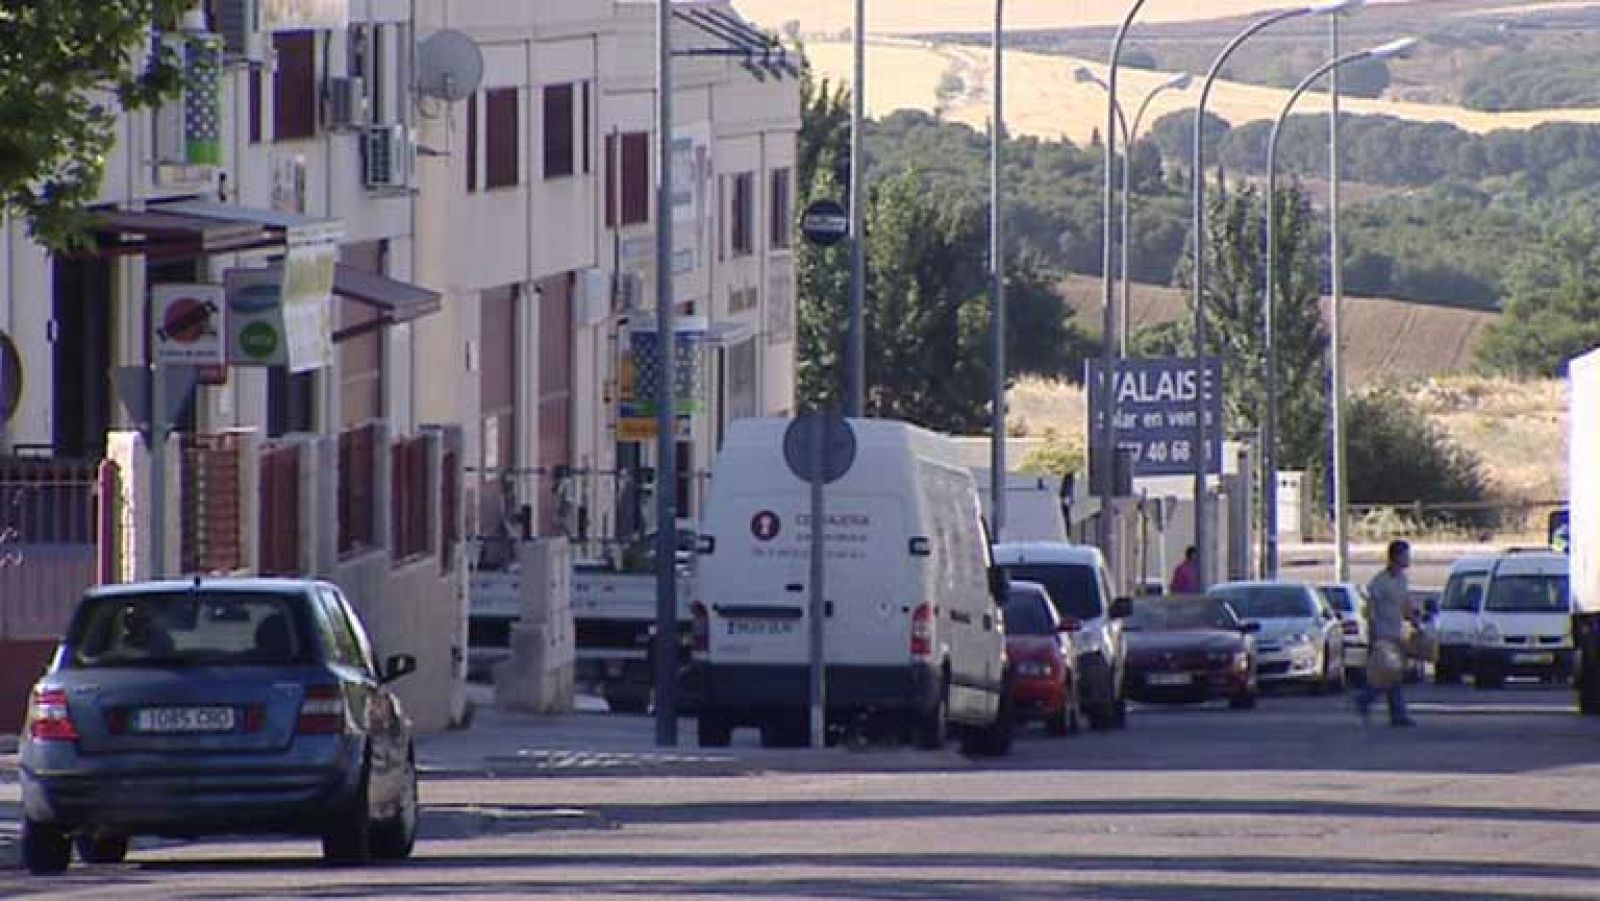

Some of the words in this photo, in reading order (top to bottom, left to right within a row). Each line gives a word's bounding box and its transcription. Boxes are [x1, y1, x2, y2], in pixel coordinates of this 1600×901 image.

[1143, 413, 1163, 428] en
[1167, 411, 1213, 427] vena
[1147, 441, 1168, 461] 40
